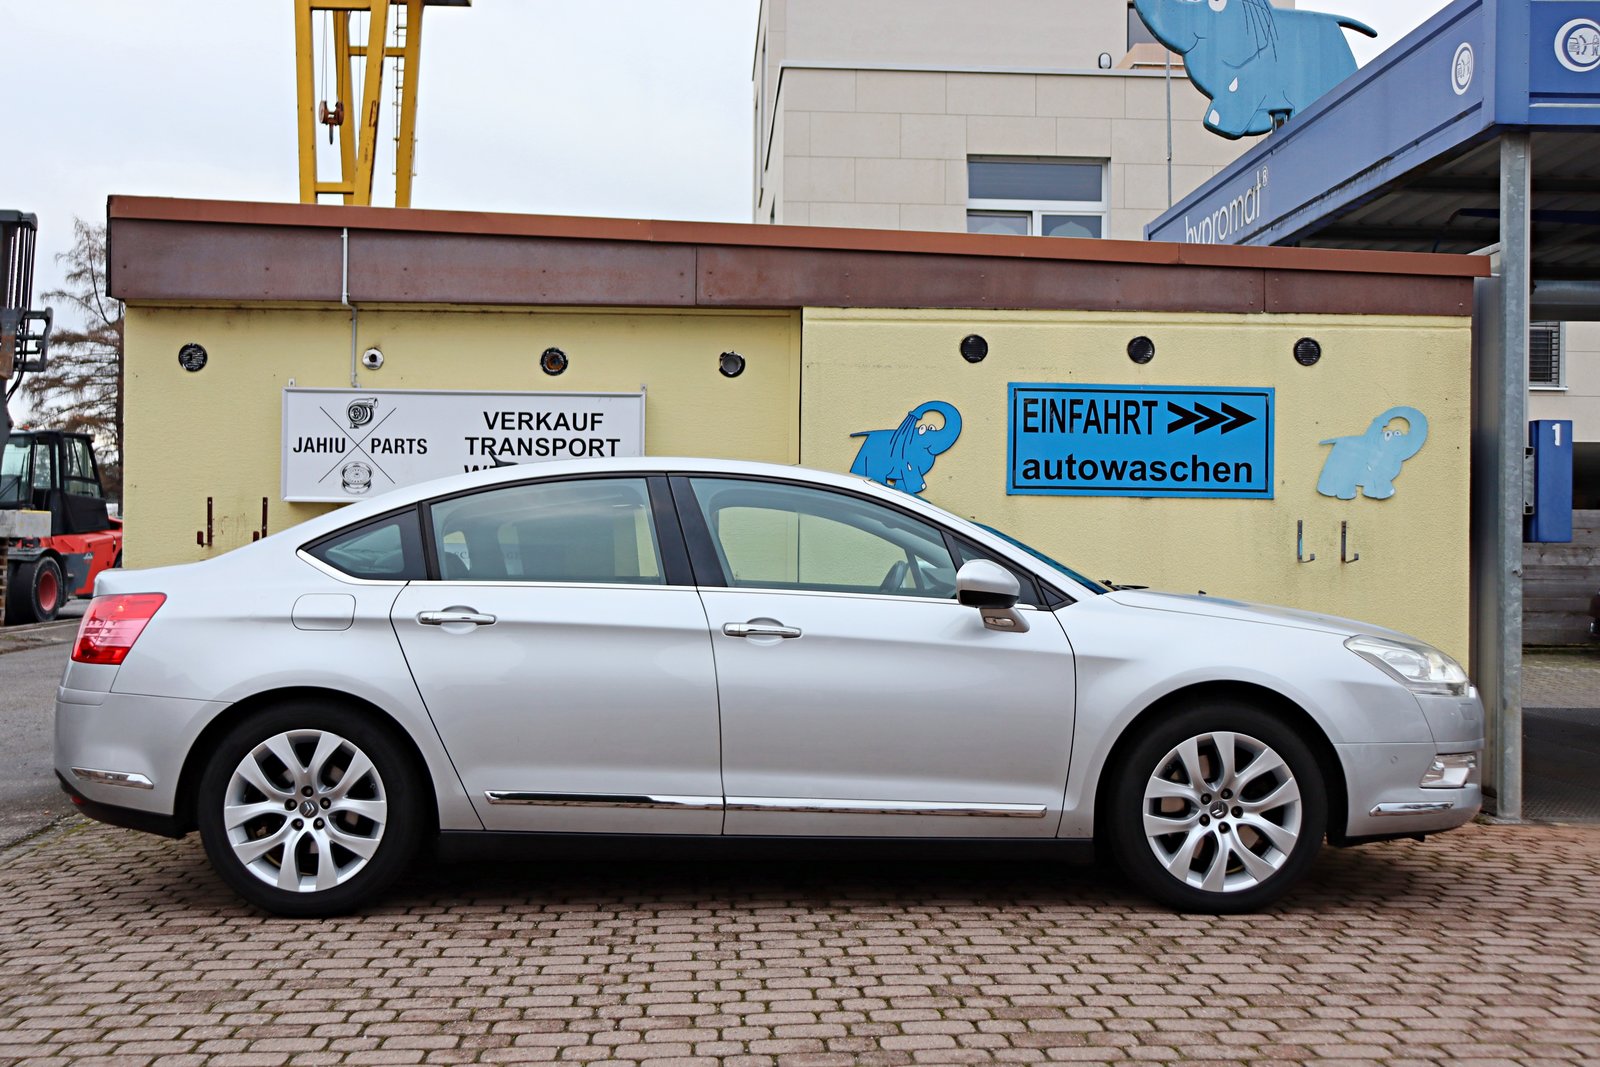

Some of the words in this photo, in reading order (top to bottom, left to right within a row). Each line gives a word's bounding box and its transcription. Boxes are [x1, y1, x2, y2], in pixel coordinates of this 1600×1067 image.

[483, 411, 604, 432] VERKAUF
[1023, 398, 1158, 435] EINFAHRT
[293, 437, 346, 453] JAHIU
[370, 438, 428, 454] PARTS
[1552, 423, 1561, 446] 1
[465, 437, 620, 457] TRANSPORT
[1022, 453, 1253, 483] autowaschen
